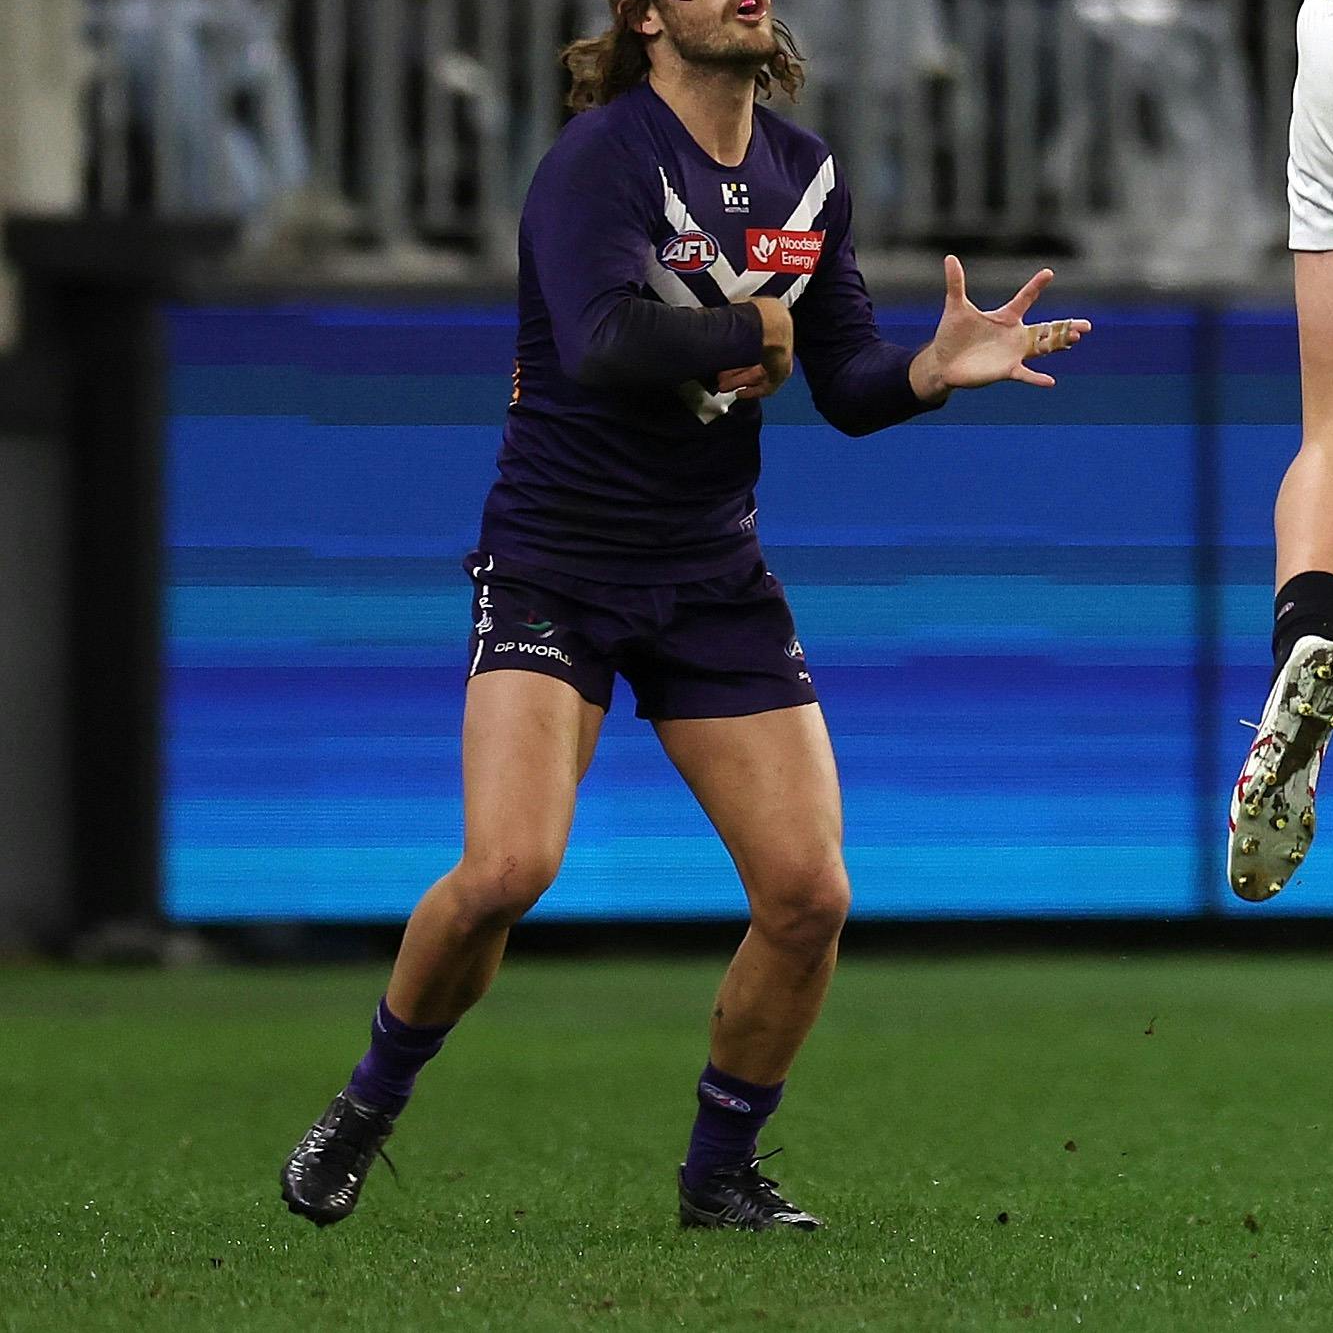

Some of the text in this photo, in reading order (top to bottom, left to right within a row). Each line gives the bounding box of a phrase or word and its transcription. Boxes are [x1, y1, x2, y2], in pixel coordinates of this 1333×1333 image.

[660, 240, 716, 263] AFL
[778, 236, 823, 251] Woodside
[781, 253, 815, 270] Energy
[494, 641, 516, 653] DP
